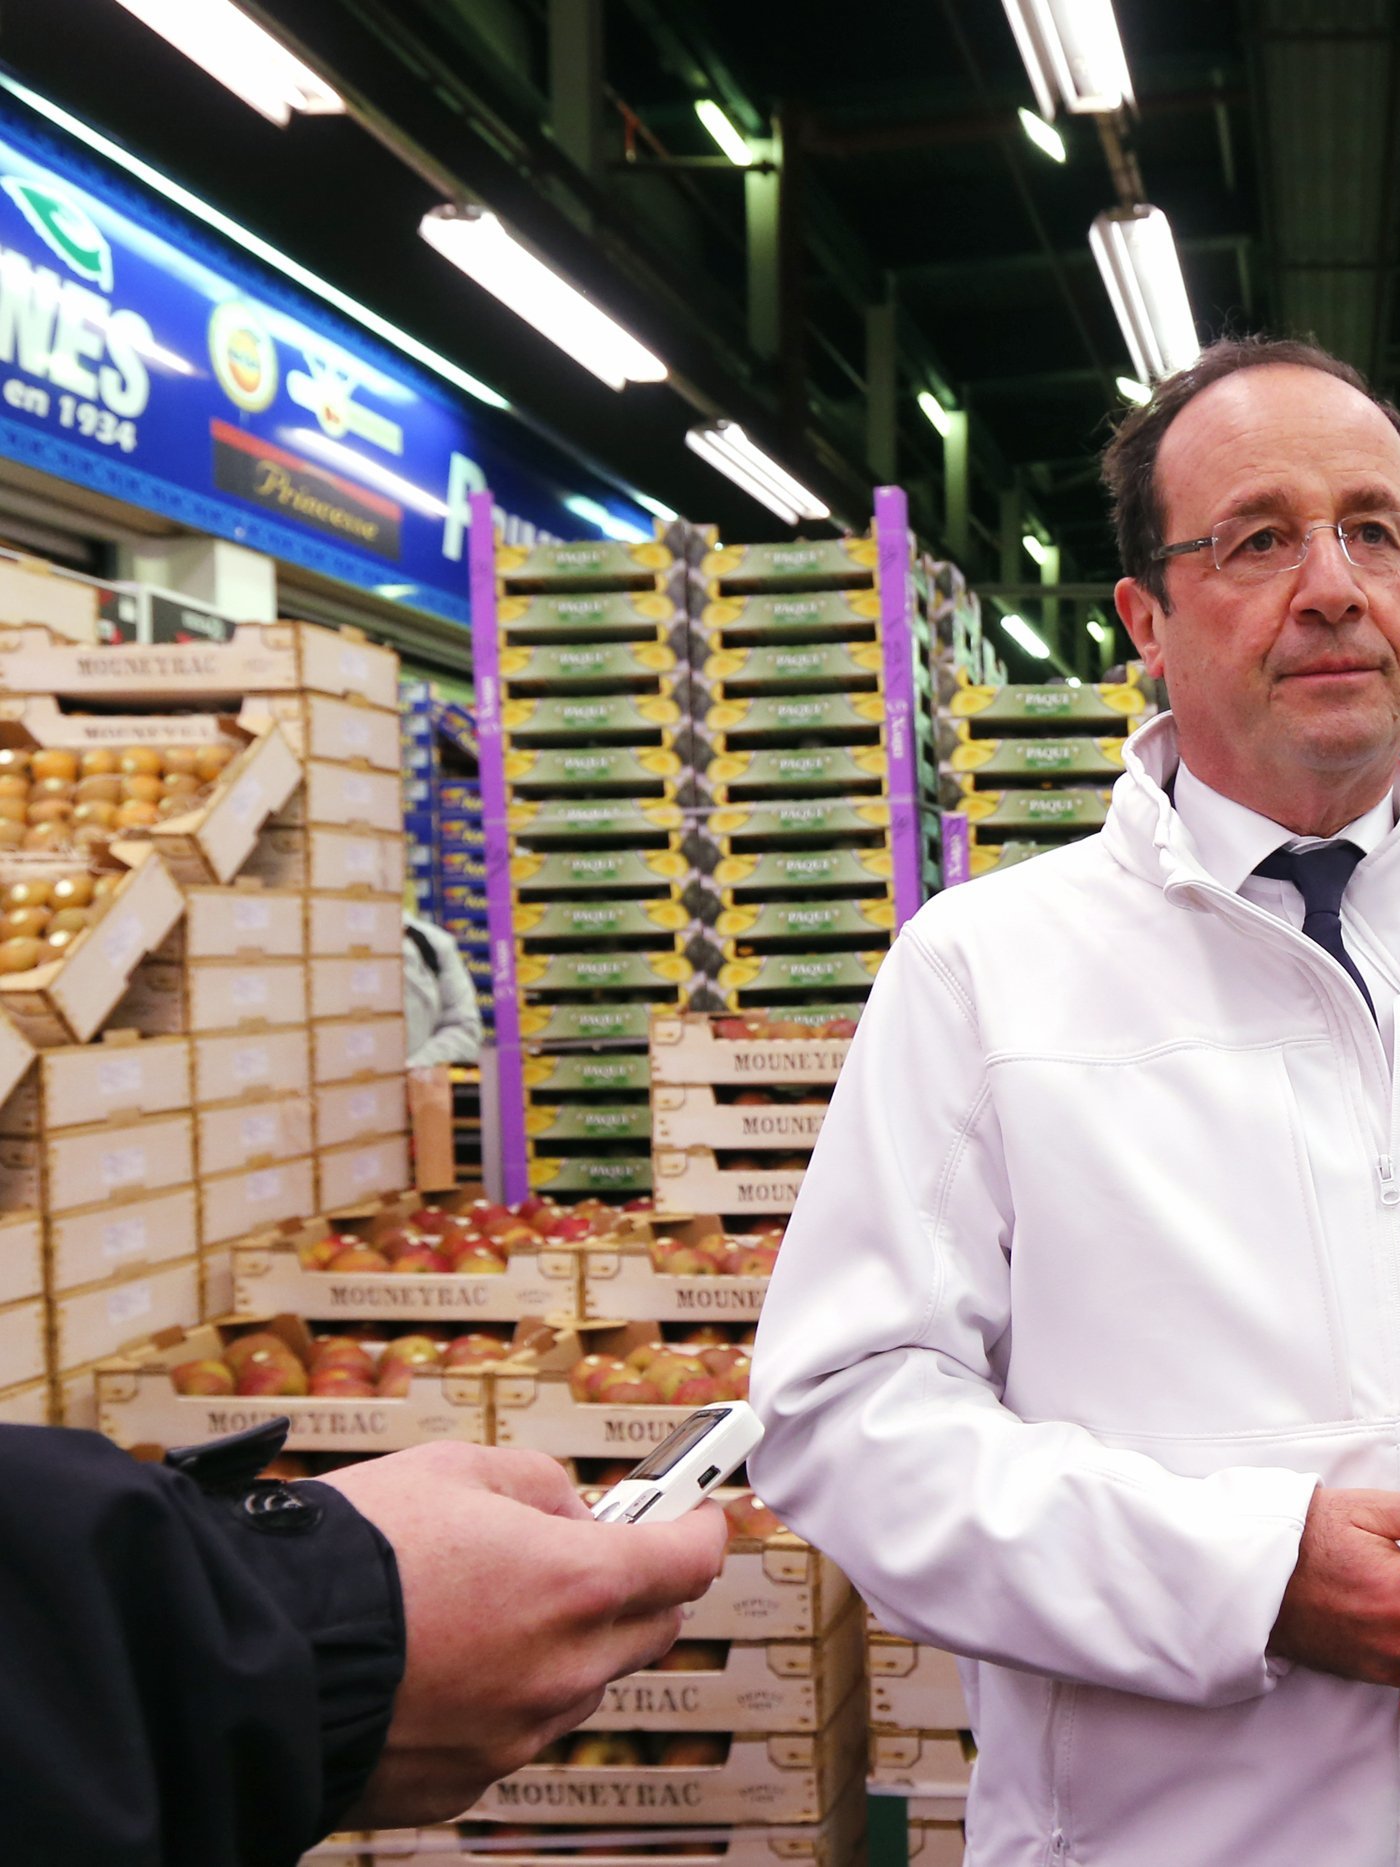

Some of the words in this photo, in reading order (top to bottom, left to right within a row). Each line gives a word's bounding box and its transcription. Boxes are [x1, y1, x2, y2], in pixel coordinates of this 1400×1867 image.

[3, 378, 50, 418] en
[58, 395, 137, 454] 1934
[743, 1117, 824, 1134] MOUNE
[329, 1285, 487, 1308] MOUNEYRAC
[676, 1289, 765, 1308] MOUNE
[498, 1780, 699, 1807] MOUNEYRAC
